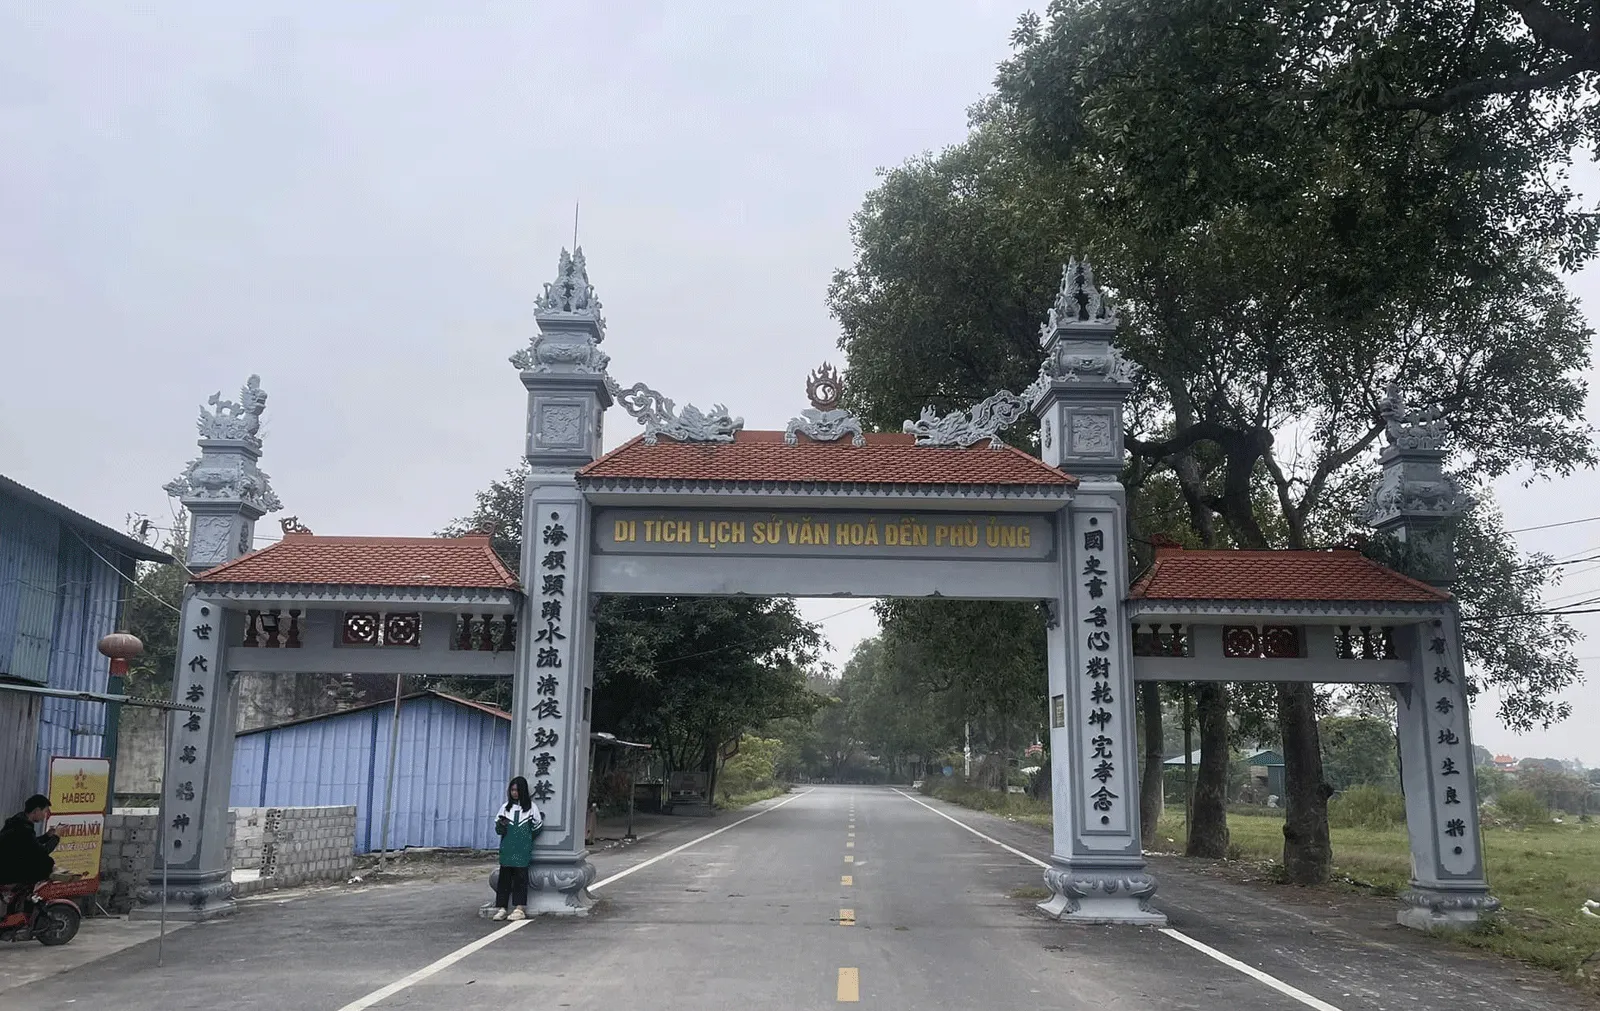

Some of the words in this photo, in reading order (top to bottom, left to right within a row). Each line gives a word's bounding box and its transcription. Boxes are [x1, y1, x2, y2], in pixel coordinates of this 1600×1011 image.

[614, 520, 636, 543] DI
[644, 515, 691, 543] TÍCH
[697, 520, 746, 549] LỊCH
[786, 516, 829, 545] VĂN
[836, 516, 879, 546] HOÁ
[935, 518, 978, 548] PHÙ
[986, 515, 1031, 548] ỦNG
[61, 792, 96, 804] HABECO
